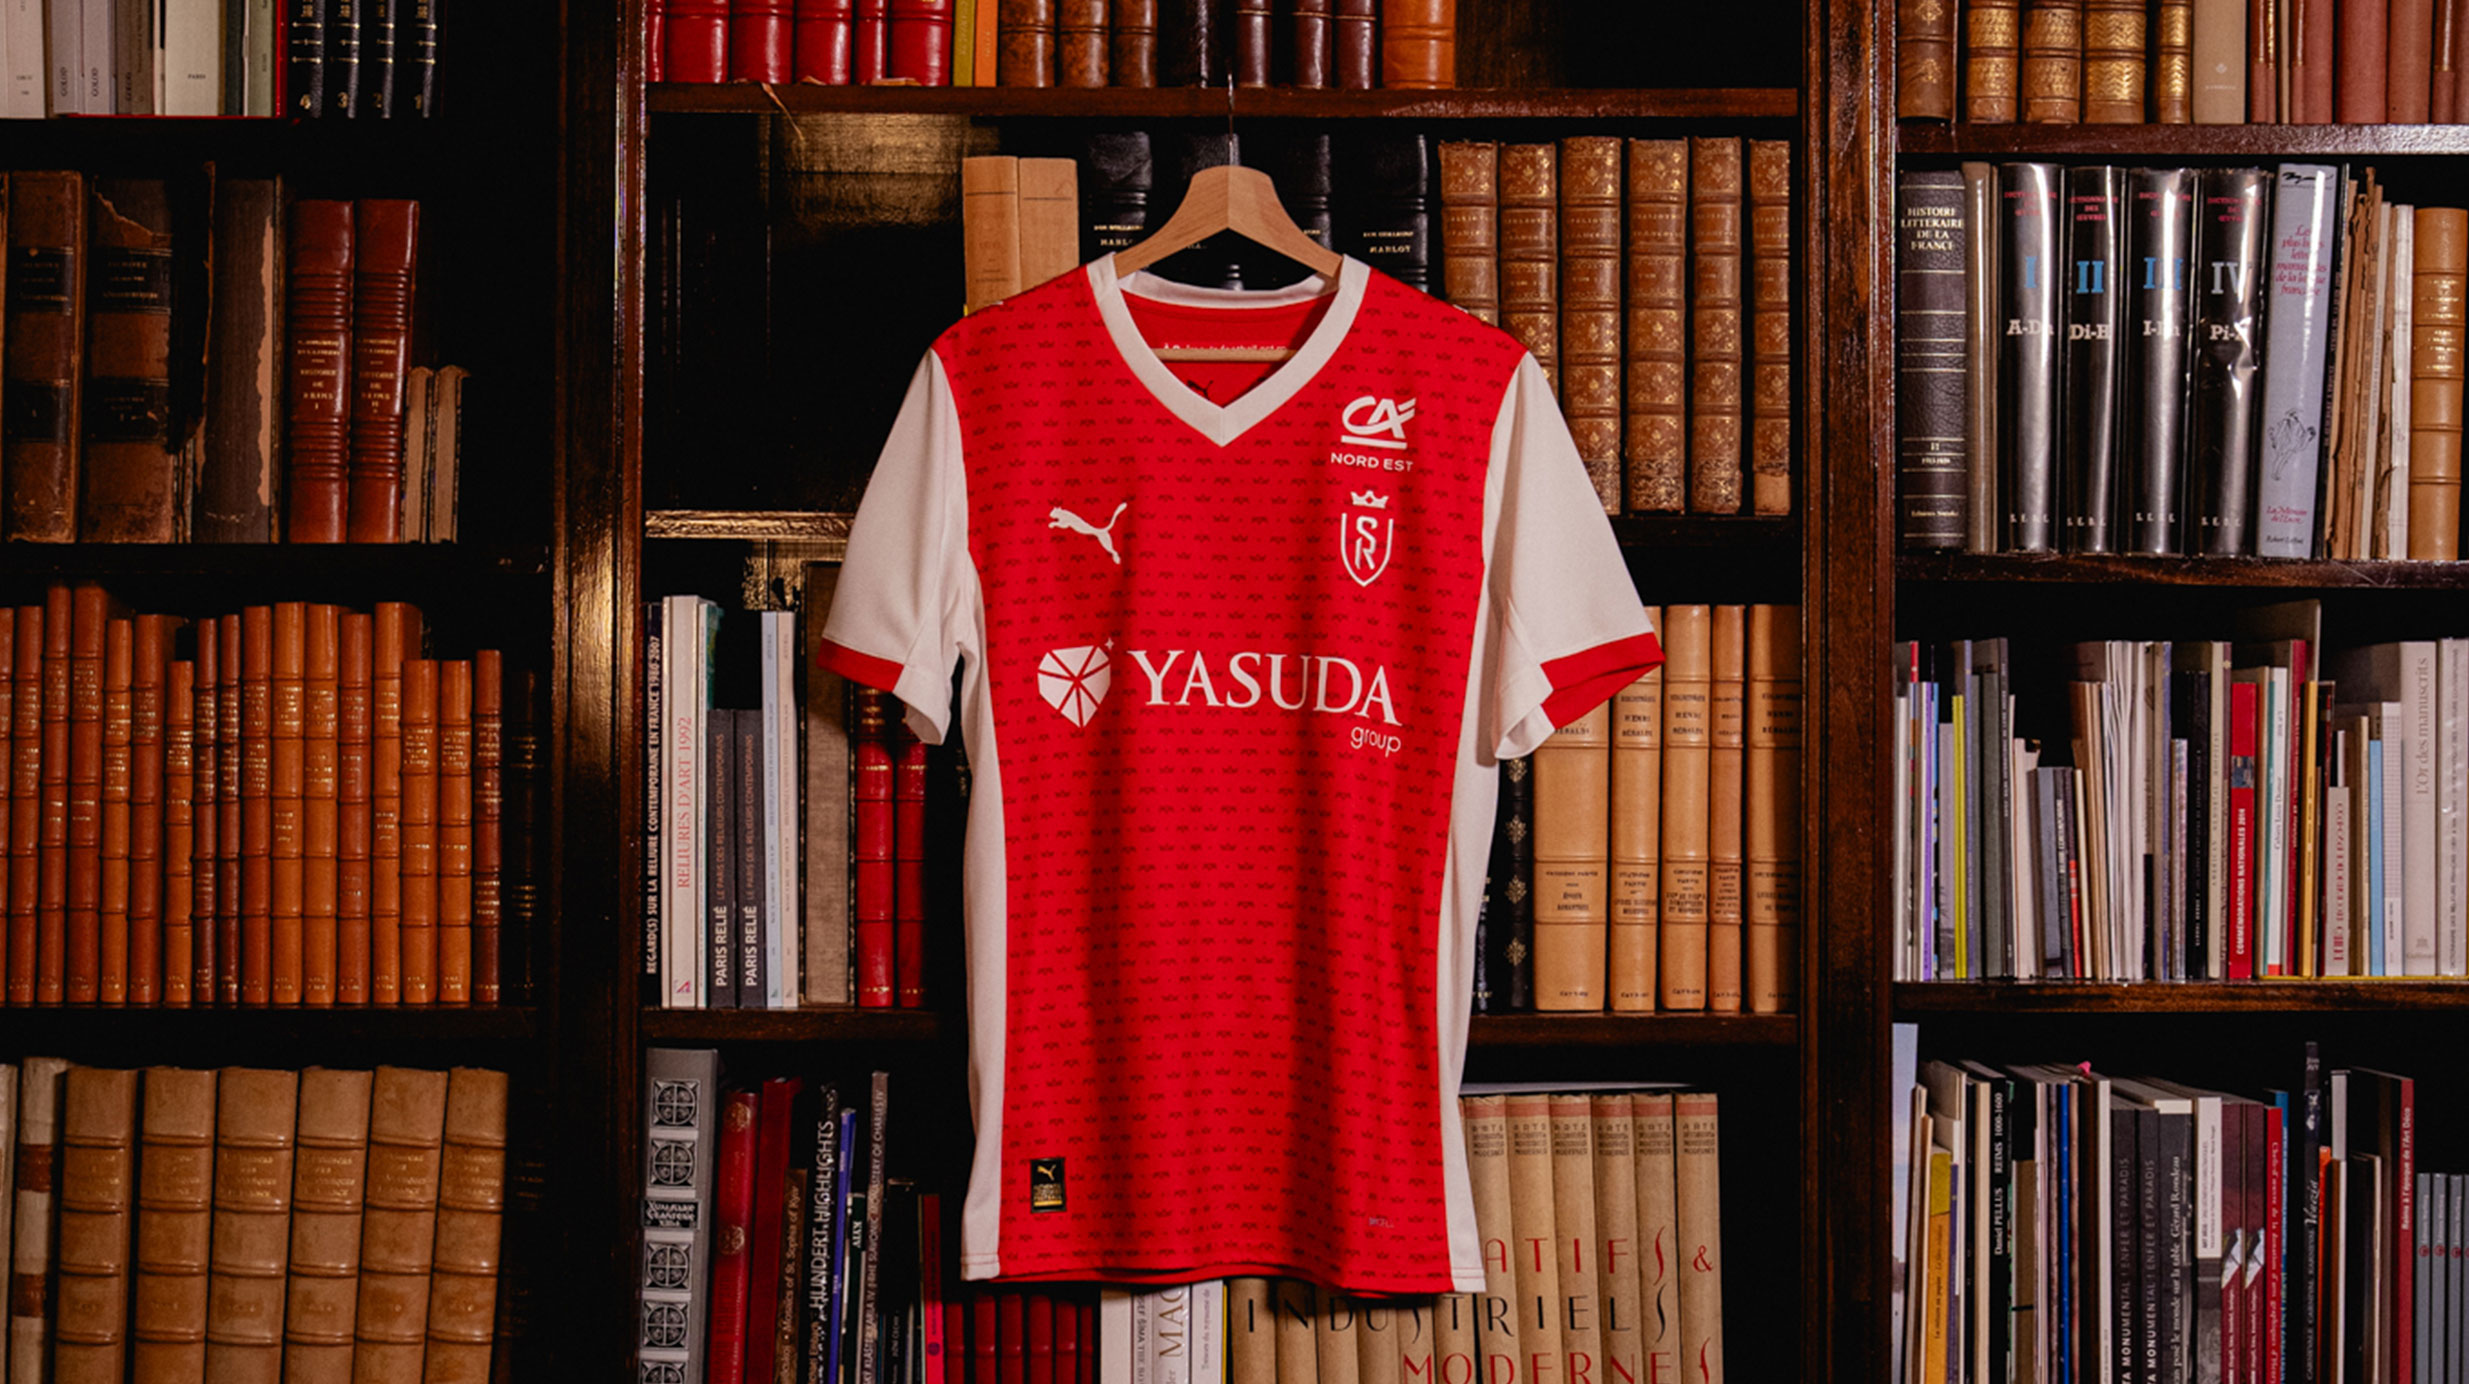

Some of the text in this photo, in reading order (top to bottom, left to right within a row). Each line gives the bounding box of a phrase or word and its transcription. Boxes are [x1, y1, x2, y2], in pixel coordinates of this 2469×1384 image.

[337, 92, 348, 109] 3
[1907, 206, 1957, 217] HISTOIRE
[1911, 241, 1955, 252] FRANCE
[1916, 231, 1950, 240] DE LA
[2025, 256, 2038, 288] I
[2076, 261, 2105, 294] II
[2143, 257, 2184, 291] II
[1330, 452, 1414, 472] NORD EST
[1127, 649, 1403, 727] YASUDA
[648, 690, 660, 729] FRANCE
[2415, 657, 2429, 795] L'Or des manuscrits
[648, 731, 660, 745] EN
[1350, 727, 1402, 759] group
[647, 746, 659, 832] CONTEMPORAINE
[676, 716, 692, 889] RELIURES D'ART 1992
[647, 835, 659, 876] RELIURE
[2237, 827, 2246, 876] NATIONALES
[647, 878, 658, 892] LA
[647, 894, 658, 915] SUR
[646, 917, 658, 974] REGARD(S)
[712, 905, 728, 987] PARIS RELIÉ
[742, 905, 758, 987] PARIS RELIÉ
[873, 1102, 884, 1142] CHARLES
[2401, 1107, 2410, 1128] Déco
[873, 1143, 882, 1157] OF
[2401, 1130, 2410, 1147] l'Art
[2401, 1150, 2410, 1160] de
[869, 1158, 882, 1215] MONASTERY
[1994, 1092, 2003, 1255] Daniel PELLUS REIMS 1000-1600
[2170, 1156, 2180, 1202] Rondeau
[2401, 1162, 2411, 1196] l'époque
[787, 1211, 798, 1223] of
[809, 1120, 834, 1308] HUNDERT HIGHLIGHTS
[2169, 1203, 2181, 1238] Gérard
[2401, 1205, 2410, 1230] Reims
[785, 1224, 798, 1259] Sophia
[867, 1217, 879, 1262] SLAVONIC
[1484, 1226, 1715, 1287] ATIFS &
[2170, 1242, 2181, 1267] table
[2118, 1158, 2132, 1367] MONUMENTAL ENFER ET PARADIS
[2144, 1160, 2157, 1369] MONUMENTAL ENFER ET PARADIS
[2170, 1268, 2180, 1278] la
[783, 1276, 794, 1288] of
[2172, 1279, 2181, 1295] sur
[782, 1290, 795, 1333] Mosaics
[2170, 1296, 2181, 1330] monde
[1402, 1337, 1711, 1384] MODERNES
